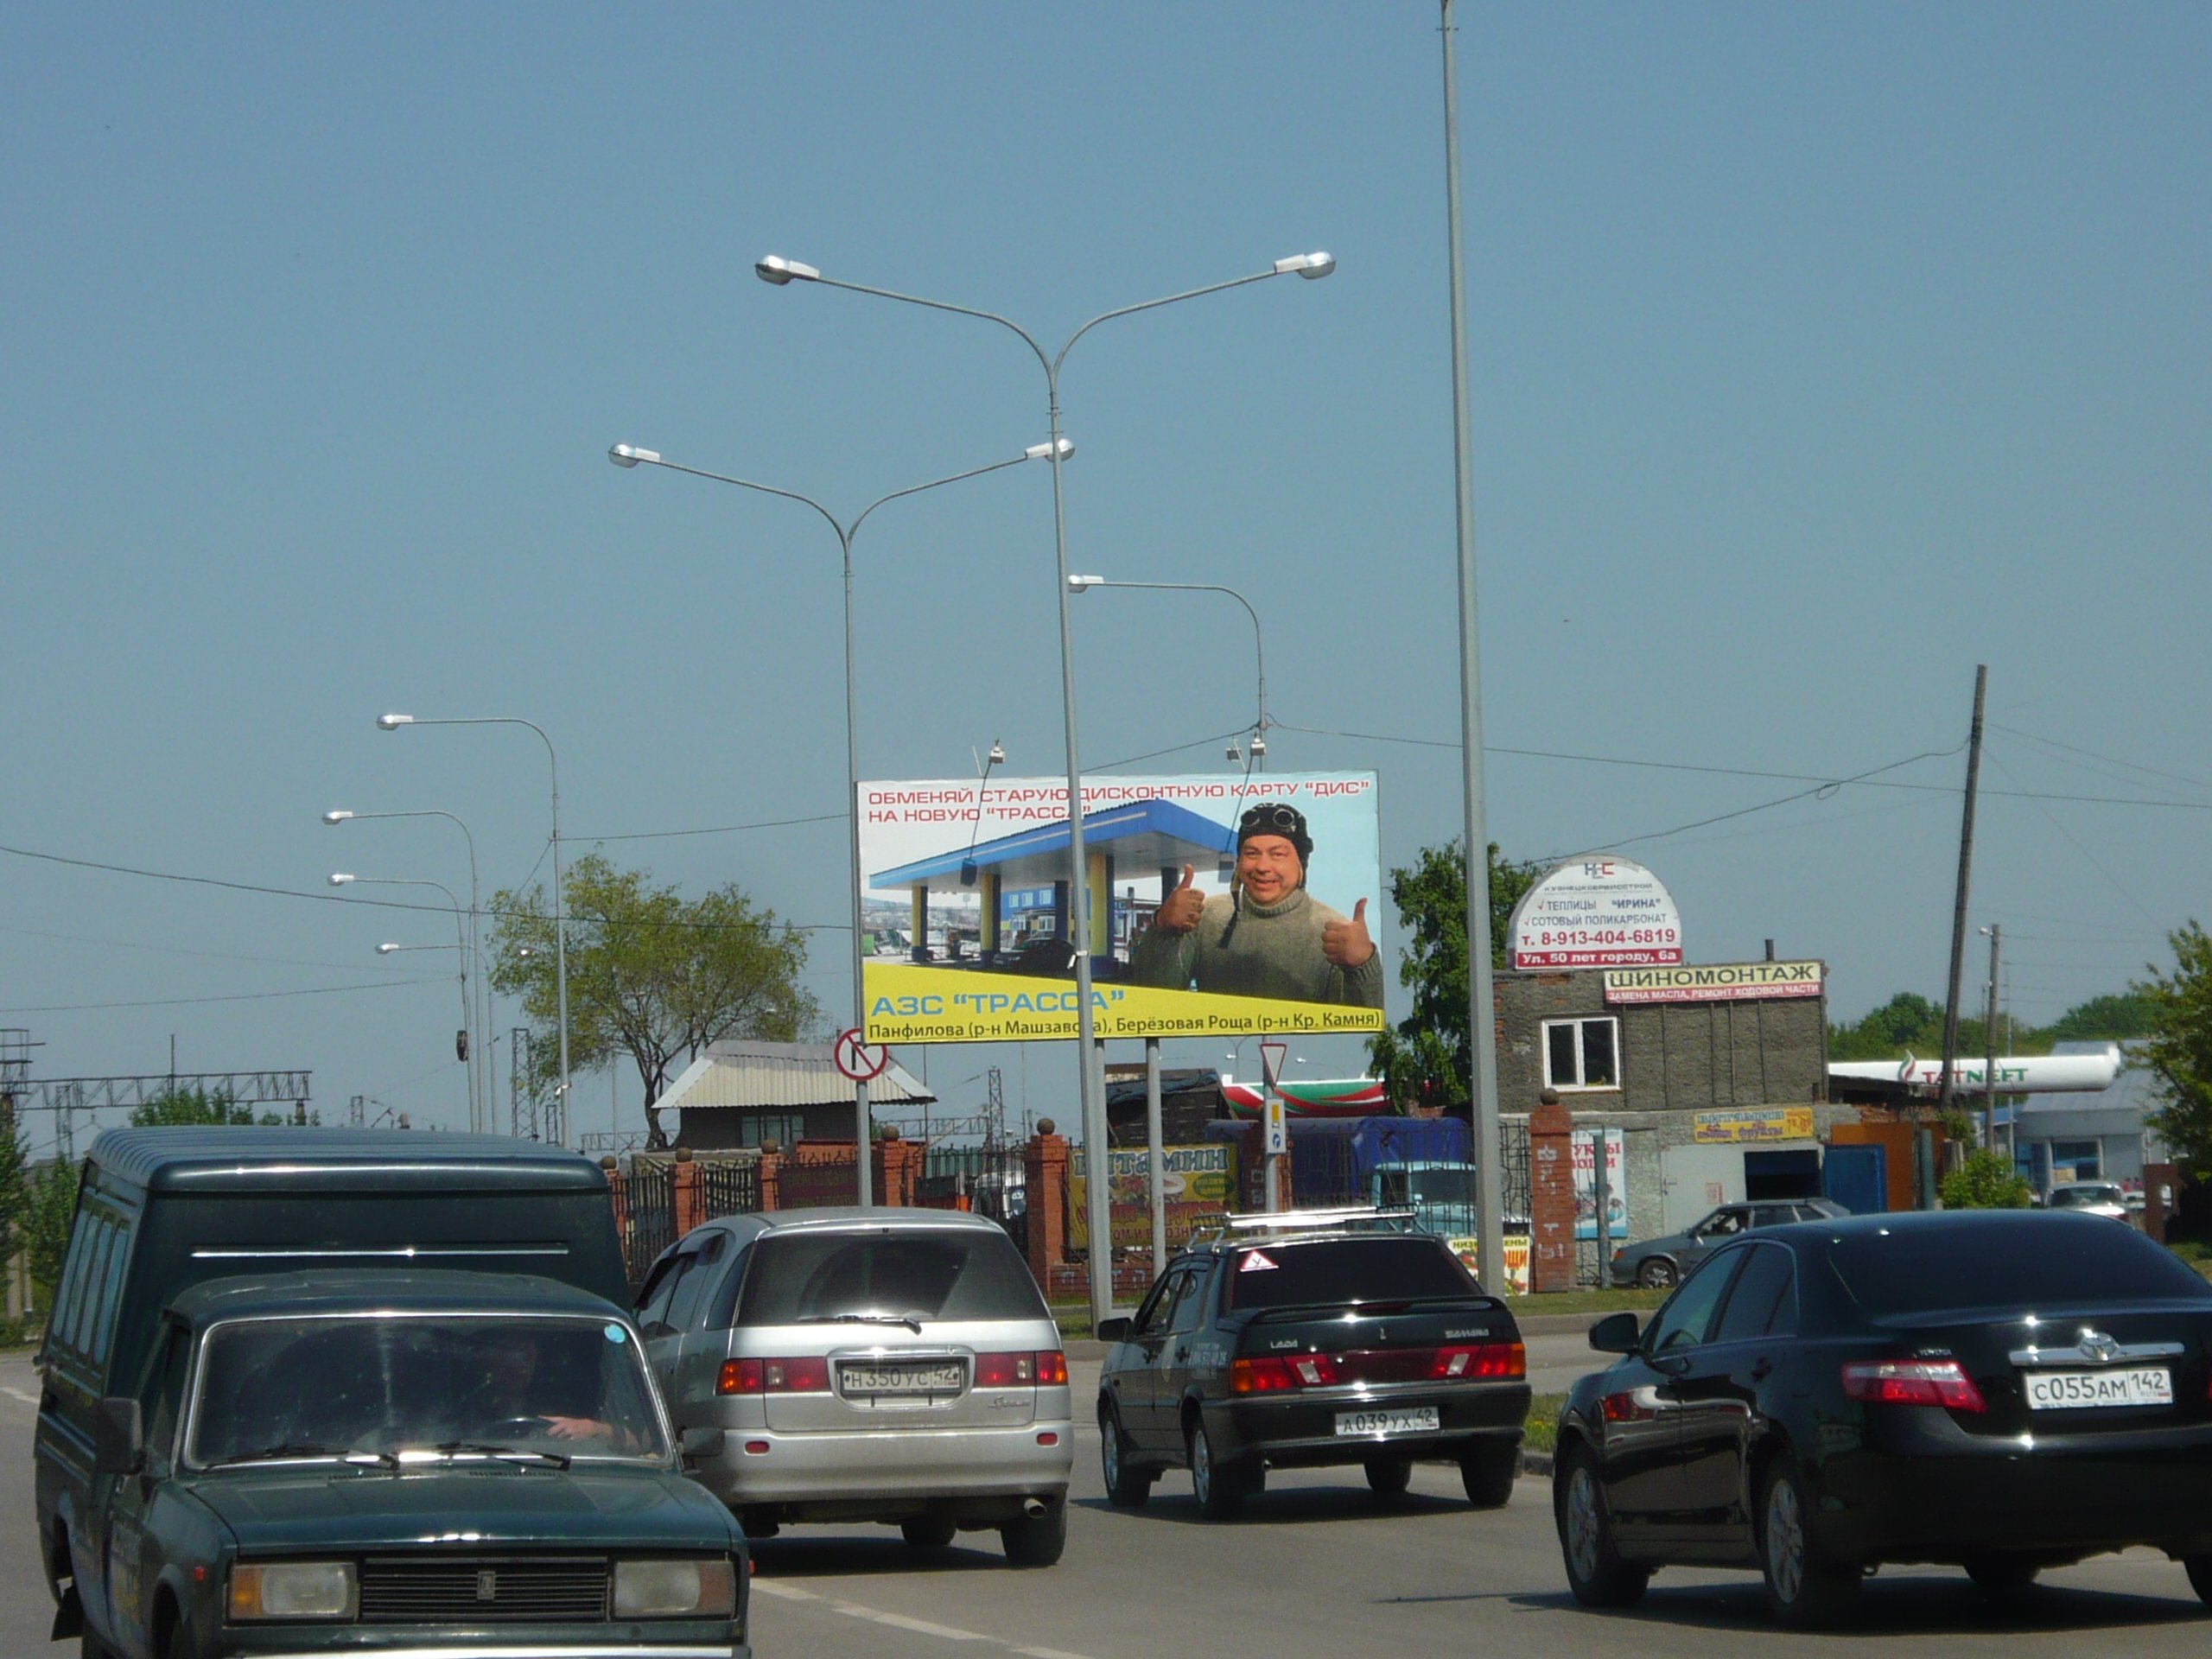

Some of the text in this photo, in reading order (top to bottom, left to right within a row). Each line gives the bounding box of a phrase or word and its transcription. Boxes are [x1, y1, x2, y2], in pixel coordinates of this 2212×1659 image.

[868, 781, 1370, 804] ОБМЕНЯЙ СТАРУЮ ДИСКОНТНУЮ КАРТУ “ДИС”
[868, 805, 1091, 823] НА НОВУЮ “ТРАСС”
[1547, 899, 1661, 912] ТЕПЛИЦЫ “ИРИНА”
[1531, 913, 1667, 926] СОТОВЫЙ ПОЛИКАРБОНАТ
[1522, 928, 1675, 946] т. 8-913-404-6819
[1522, 950, 1677, 965] Ул. 50 лет городу, 6а
[1609, 964, 1815, 988] ШИНОМОНТАЖ
[1609, 983, 1819, 1001] ЗАМЕНА МАСЛА, РЕМОНТ ХОДОВОЙ ЧАСТИ
[871, 995, 944, 1017] АЗС
[869, 1010, 1381, 1040] Панфилова (р-н Машзавоа), Берёзовая Роща (р-н Кр. Камня)
[1446, 1328, 1490, 1338] SAMARA
[1270, 1340, 1298, 1349] LADA
[2034, 1371, 2164, 1402] С055АМ 142
[1344, 1409, 1433, 1433] А039УХ 42
